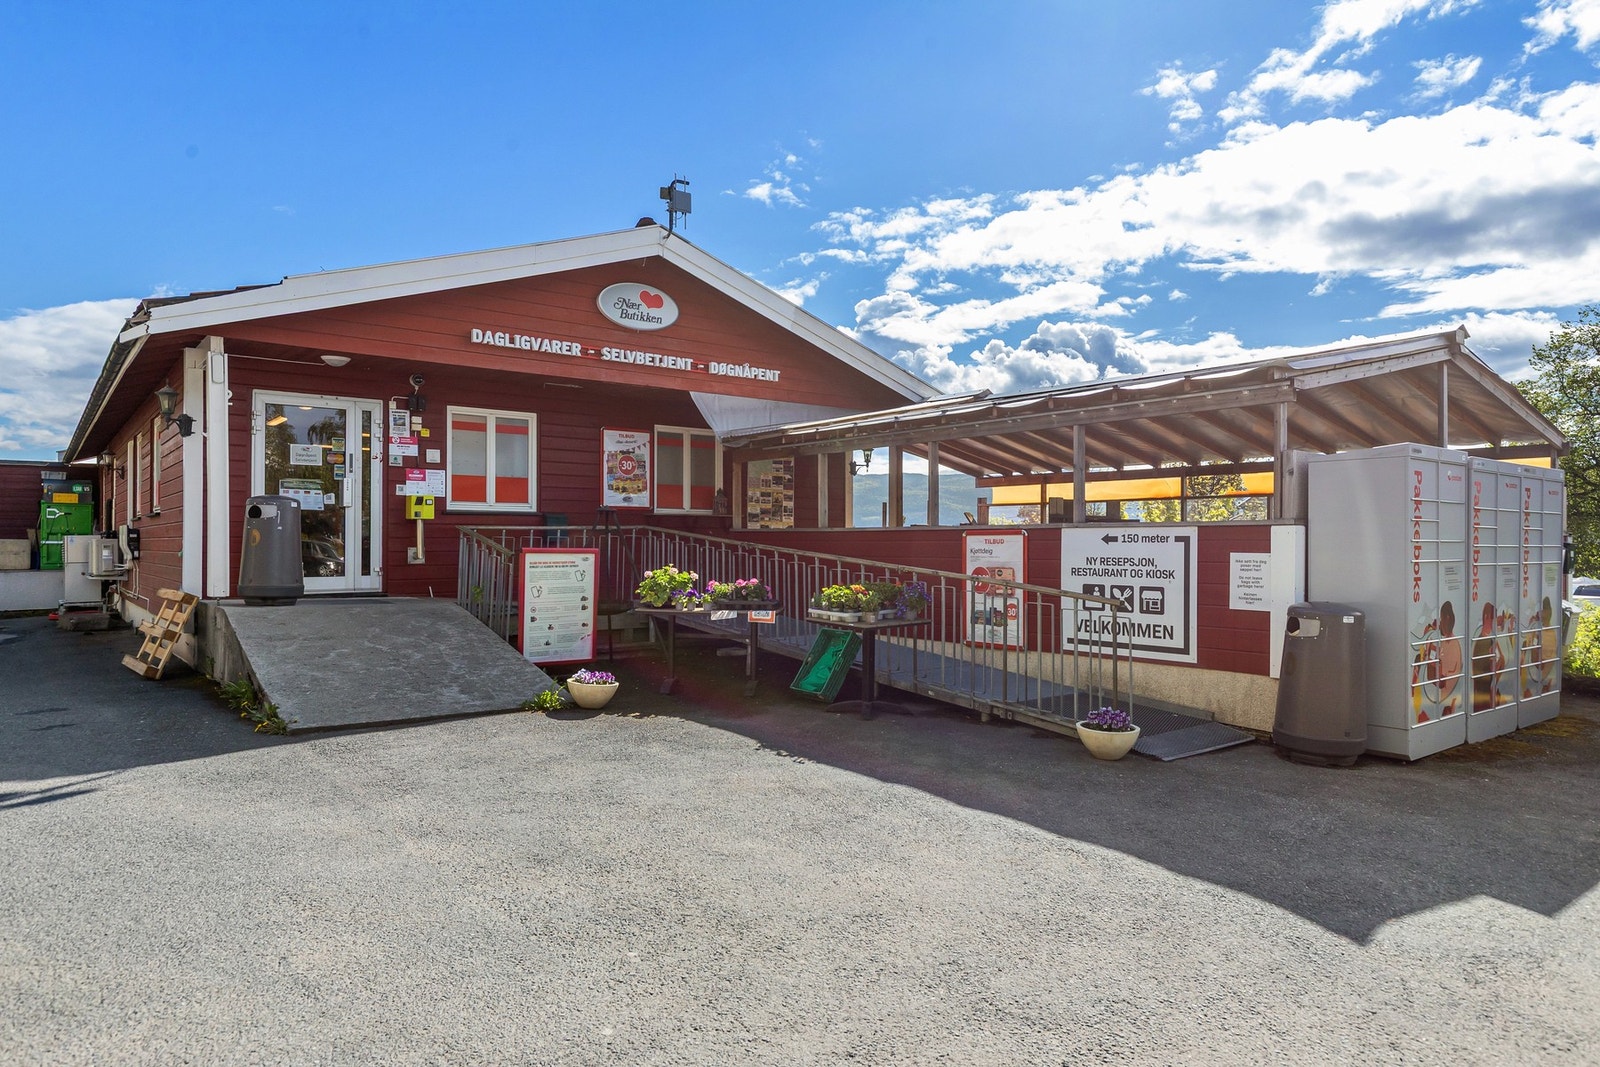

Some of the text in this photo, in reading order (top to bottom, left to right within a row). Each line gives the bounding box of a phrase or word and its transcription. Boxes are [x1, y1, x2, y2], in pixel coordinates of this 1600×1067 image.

[614, 297, 642, 310] Nær
[620, 308, 662, 324] Butikken
[470, 328, 582, 356] DAGLIGVARER
[600, 346, 694, 371] SELVBETJENT
[708, 362, 781, 382] DØGNÅPENT
[1122, 534, 1170, 543] 150 meter
[1413, 470, 1423, 604] Pakkeboks
[1472, 480, 1482, 603] Pakkeboks
[1523, 487, 1531, 598] Pakkeboks
[1086, 557, 1158, 569] NY RESEPSJON,
[1071, 568, 1175, 579] RESTAURANT OG KIOSK
[1077, 619, 1174, 640] VELKOMMEN
